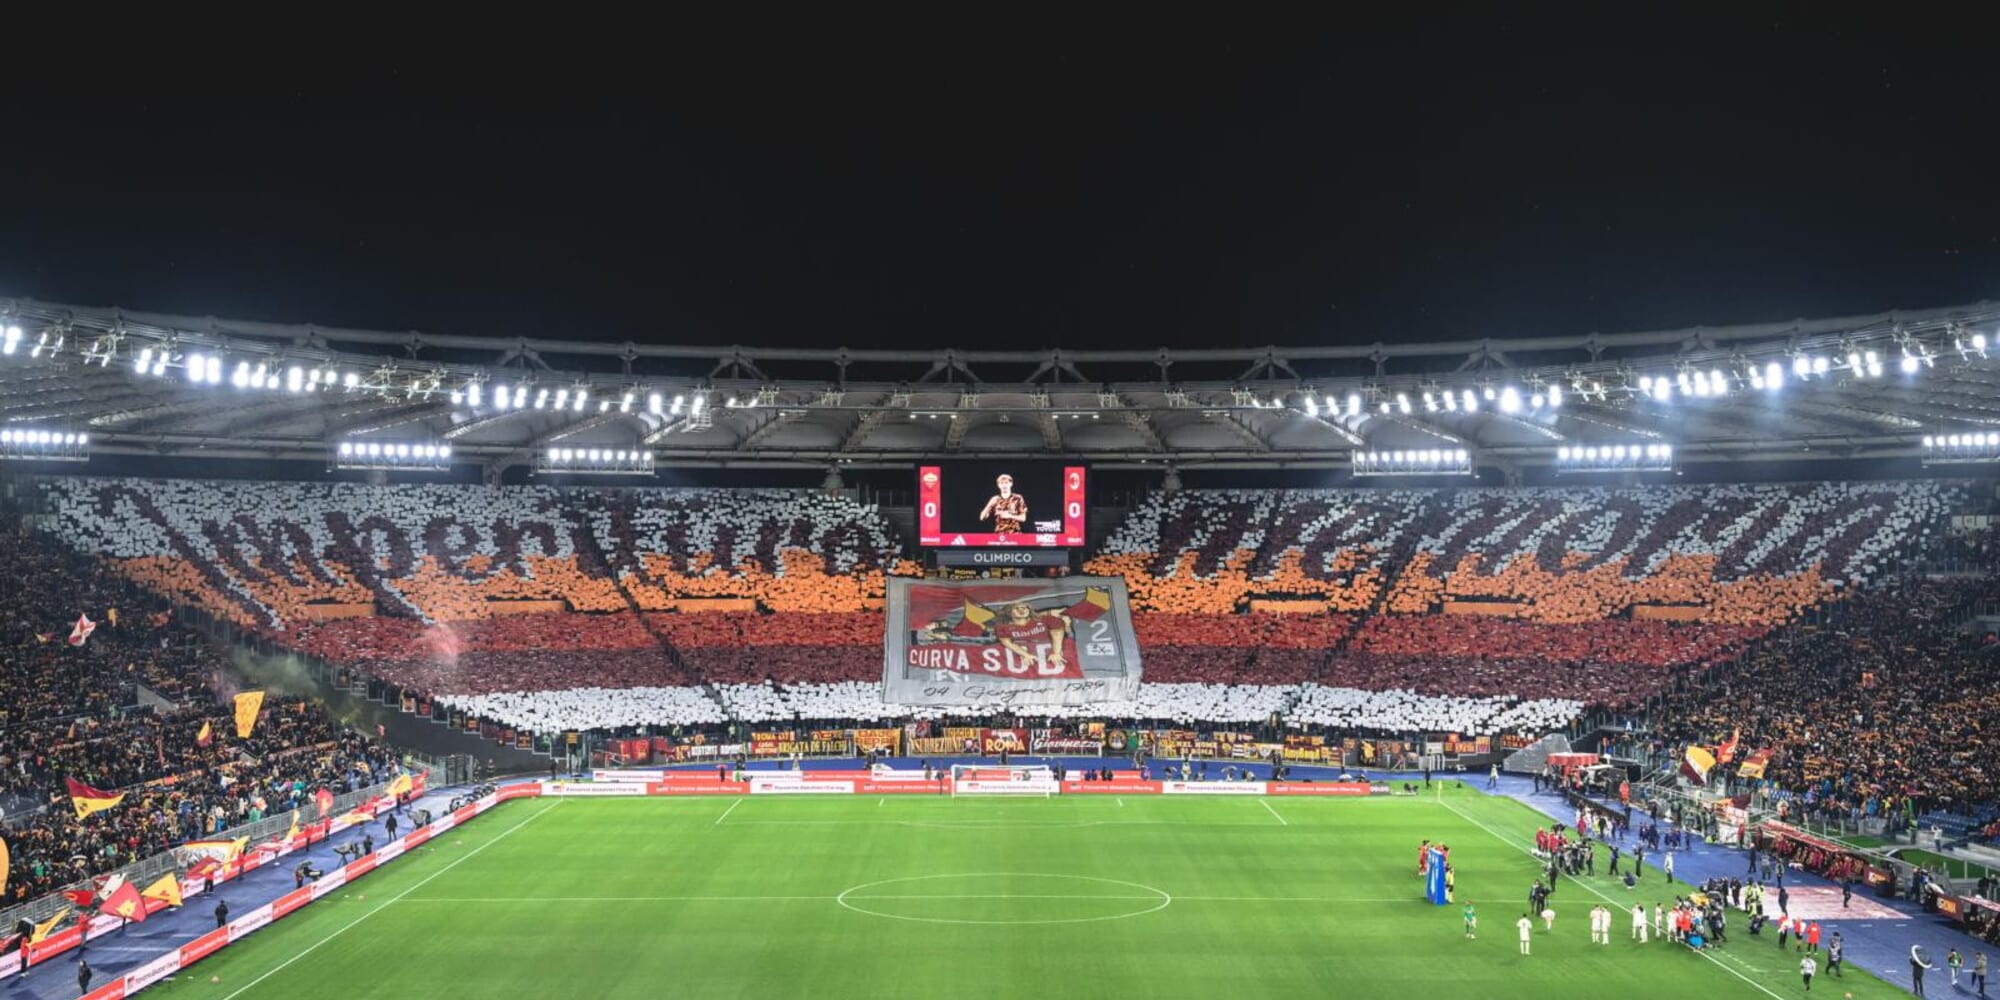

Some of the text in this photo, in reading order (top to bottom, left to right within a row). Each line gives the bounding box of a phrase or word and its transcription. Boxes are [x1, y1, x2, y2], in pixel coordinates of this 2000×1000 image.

[925, 502, 936, 518] 0
[1069, 502, 1080, 518] 0
[974, 553, 1032, 563] OLIMPICO
[1090, 620, 1112, 642] 2
[910, 648, 970, 671] CURVA
[983, 643, 1065, 676] SUD
[923, 686, 950, 697] 04
[1063, 681, 1105, 693] 1989
[986, 737, 1026, 752] ROMA
